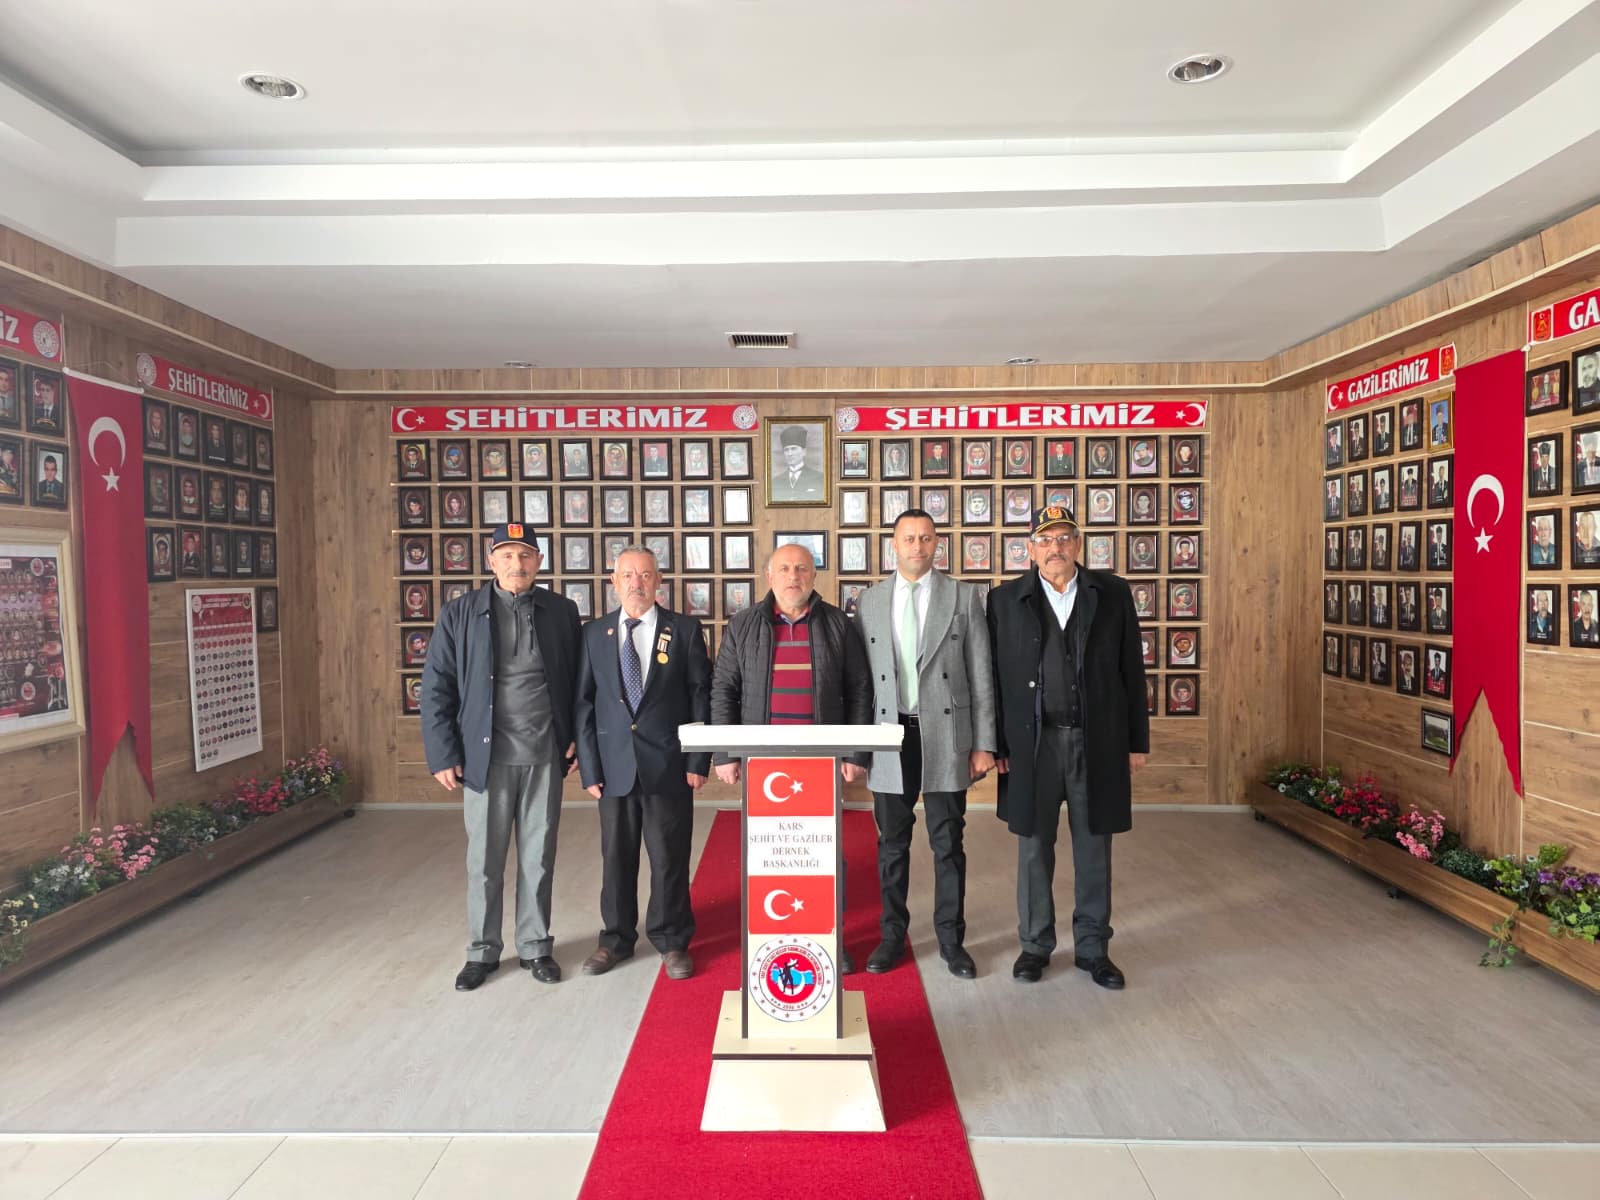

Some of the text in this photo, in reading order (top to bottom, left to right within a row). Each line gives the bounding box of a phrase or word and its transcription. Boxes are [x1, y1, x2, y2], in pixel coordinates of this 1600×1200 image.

[168, 368, 249, 411] ŞEHİTLERİMİZ
[1347, 358, 1429, 402] GAZİLERİMİZ
[445, 406, 708, 431] ŞEHİTLERİMİZ
[885, 403, 1155, 430] ŞEHİTLERİMİZ
[777, 834, 790, 843] VE
[792, 832, 833, 843] GAZİLER
[778, 822, 804, 831] KARS
[772, 847, 810, 856] DERNEK
